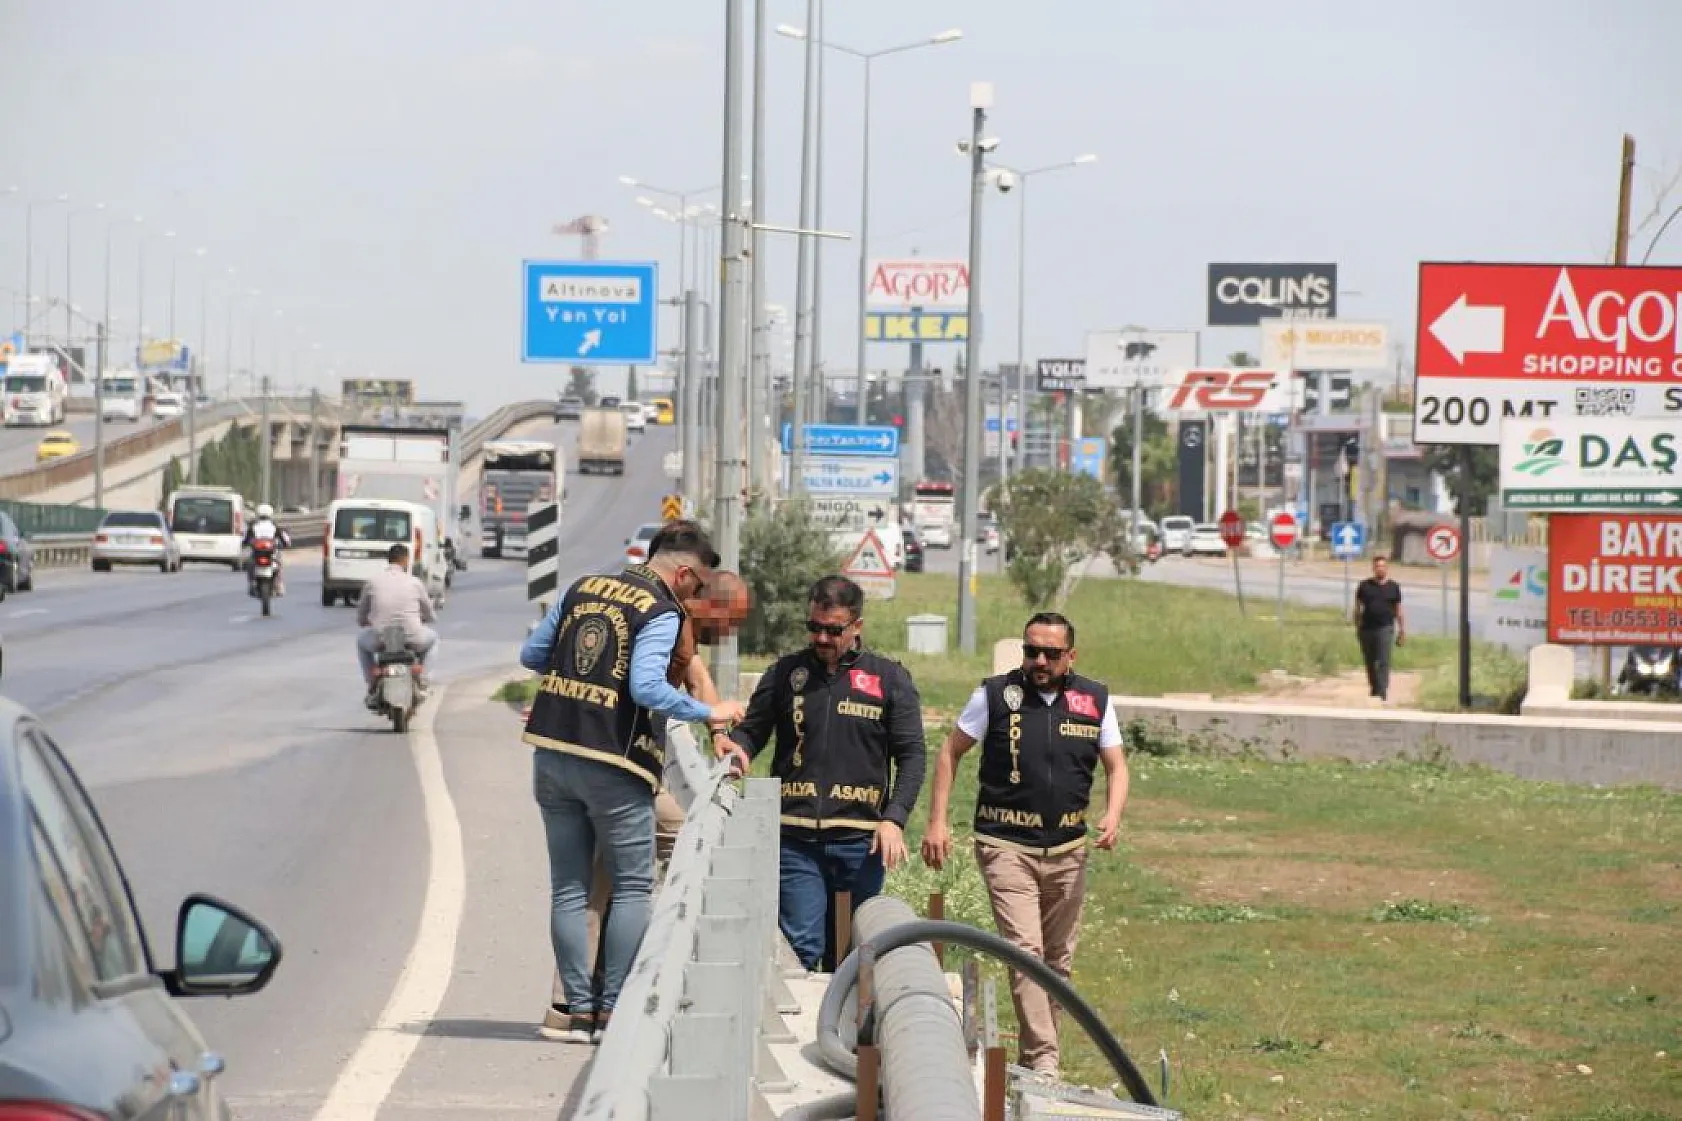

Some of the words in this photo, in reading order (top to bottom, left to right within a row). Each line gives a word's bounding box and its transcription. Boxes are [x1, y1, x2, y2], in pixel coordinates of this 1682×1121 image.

[869, 262, 970, 301] AGORA
[1217, 273, 1331, 305] COLIN'S
[545, 305, 588, 323] Yan
[592, 305, 627, 323] Yol
[866, 315, 968, 340] IKEA
[1306, 329, 1381, 346] MIGROS
[1420, 396, 1489, 426] 200
[1579, 432, 1678, 474] DAŞ
[540, 670, 619, 708] CİNAYET
[837, 696, 883, 720] CİNAYET
[1059, 719, 1101, 738] CİNAYET
[979, 804, 1043, 828] ANTALYA
